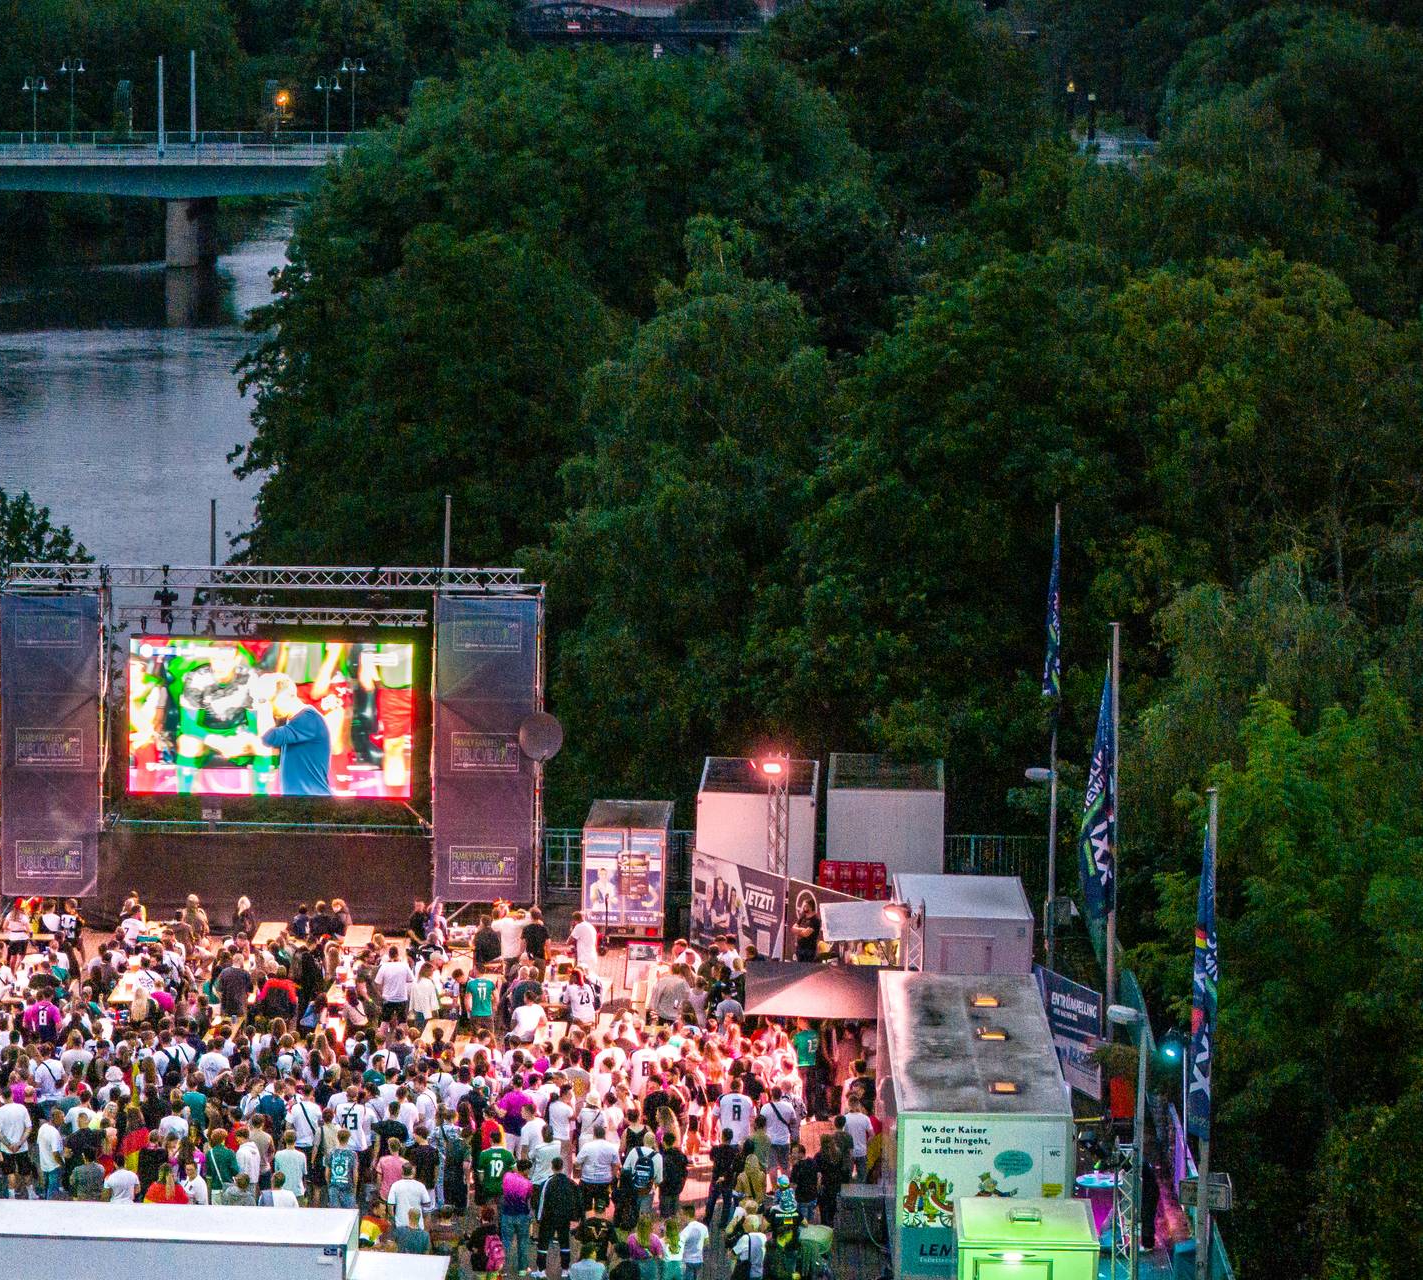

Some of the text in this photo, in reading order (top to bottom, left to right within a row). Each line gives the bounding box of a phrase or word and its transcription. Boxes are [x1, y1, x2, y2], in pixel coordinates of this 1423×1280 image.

[452, 861, 479, 874] PUBLIC
[744, 889, 775, 912] JETZT!
[579, 992, 590, 1005] 23
[39, 1010, 47, 1026] 8
[922, 1125, 937, 1133] Wo
[958, 1125, 987, 1134] Kaiser
[935, 1136, 951, 1144] Fuß
[954, 1137, 991, 1146] hingeht,
[935, 1147, 964, 1155] stehen
[490, 1160, 503, 1178] 19
